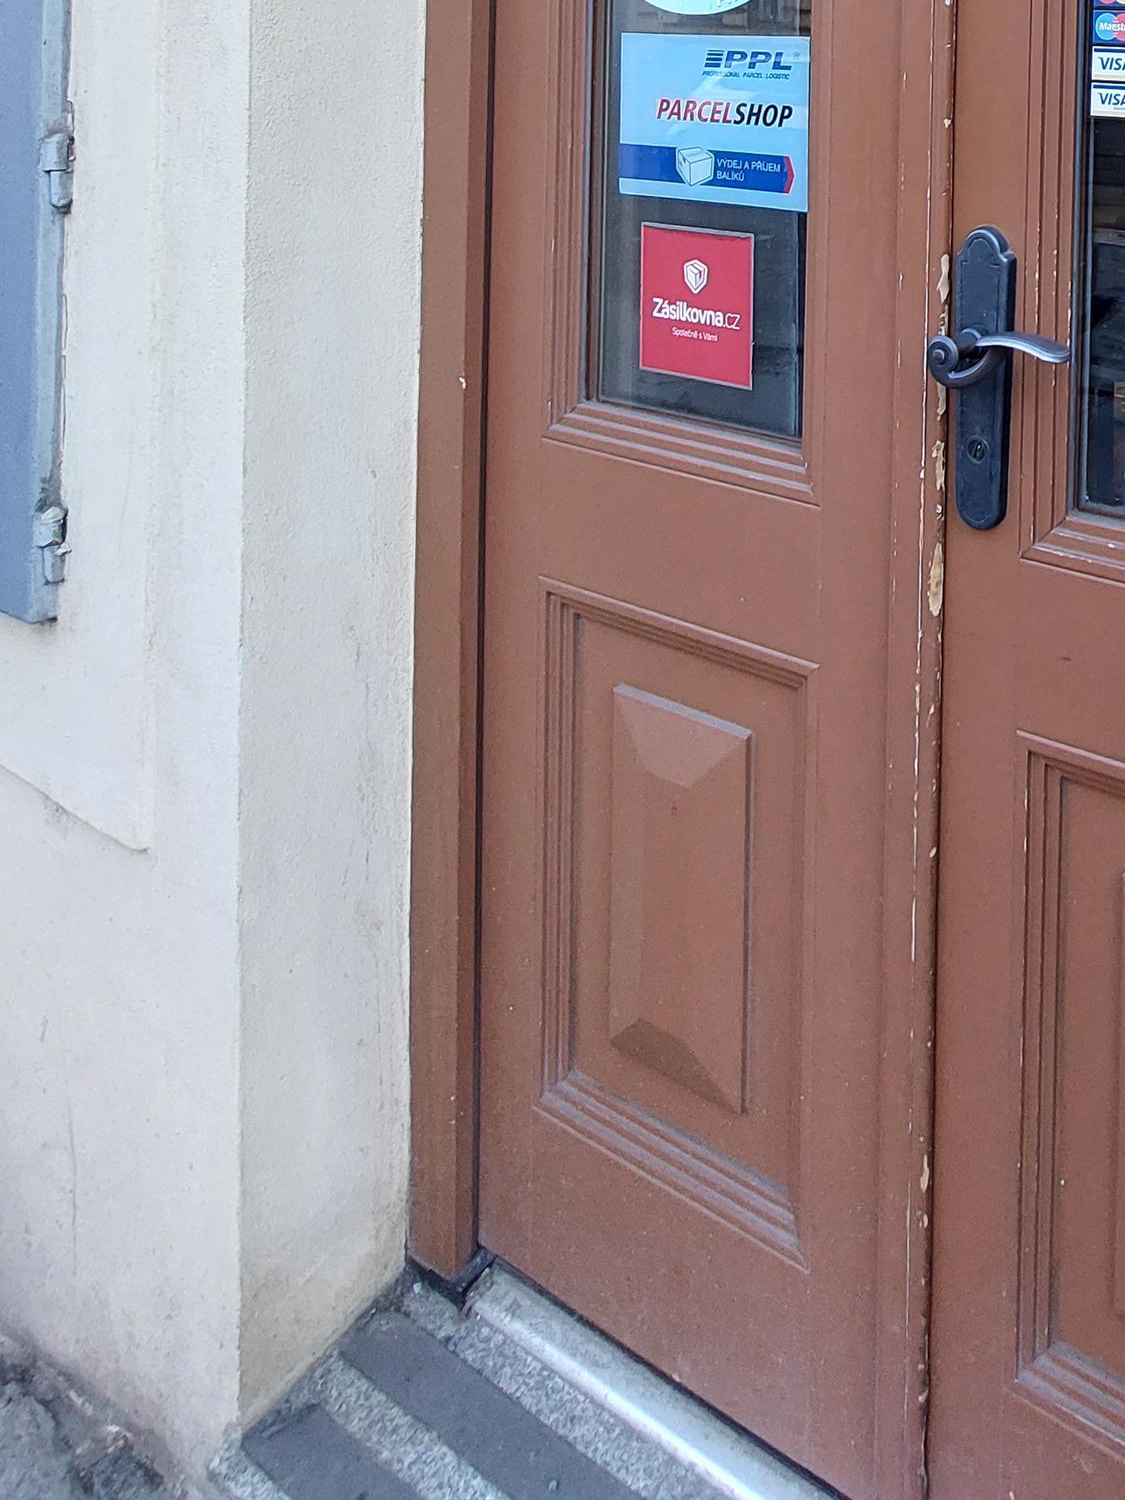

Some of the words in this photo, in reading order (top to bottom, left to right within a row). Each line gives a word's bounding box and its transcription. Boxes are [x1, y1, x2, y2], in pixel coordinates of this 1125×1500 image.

[724, 50, 792, 71] PPL
[656, 98, 793, 128] PARCELSHOP
[716, 157, 743, 170] VÝDEJ
[716, 169, 745, 181] BALÍKŮ
